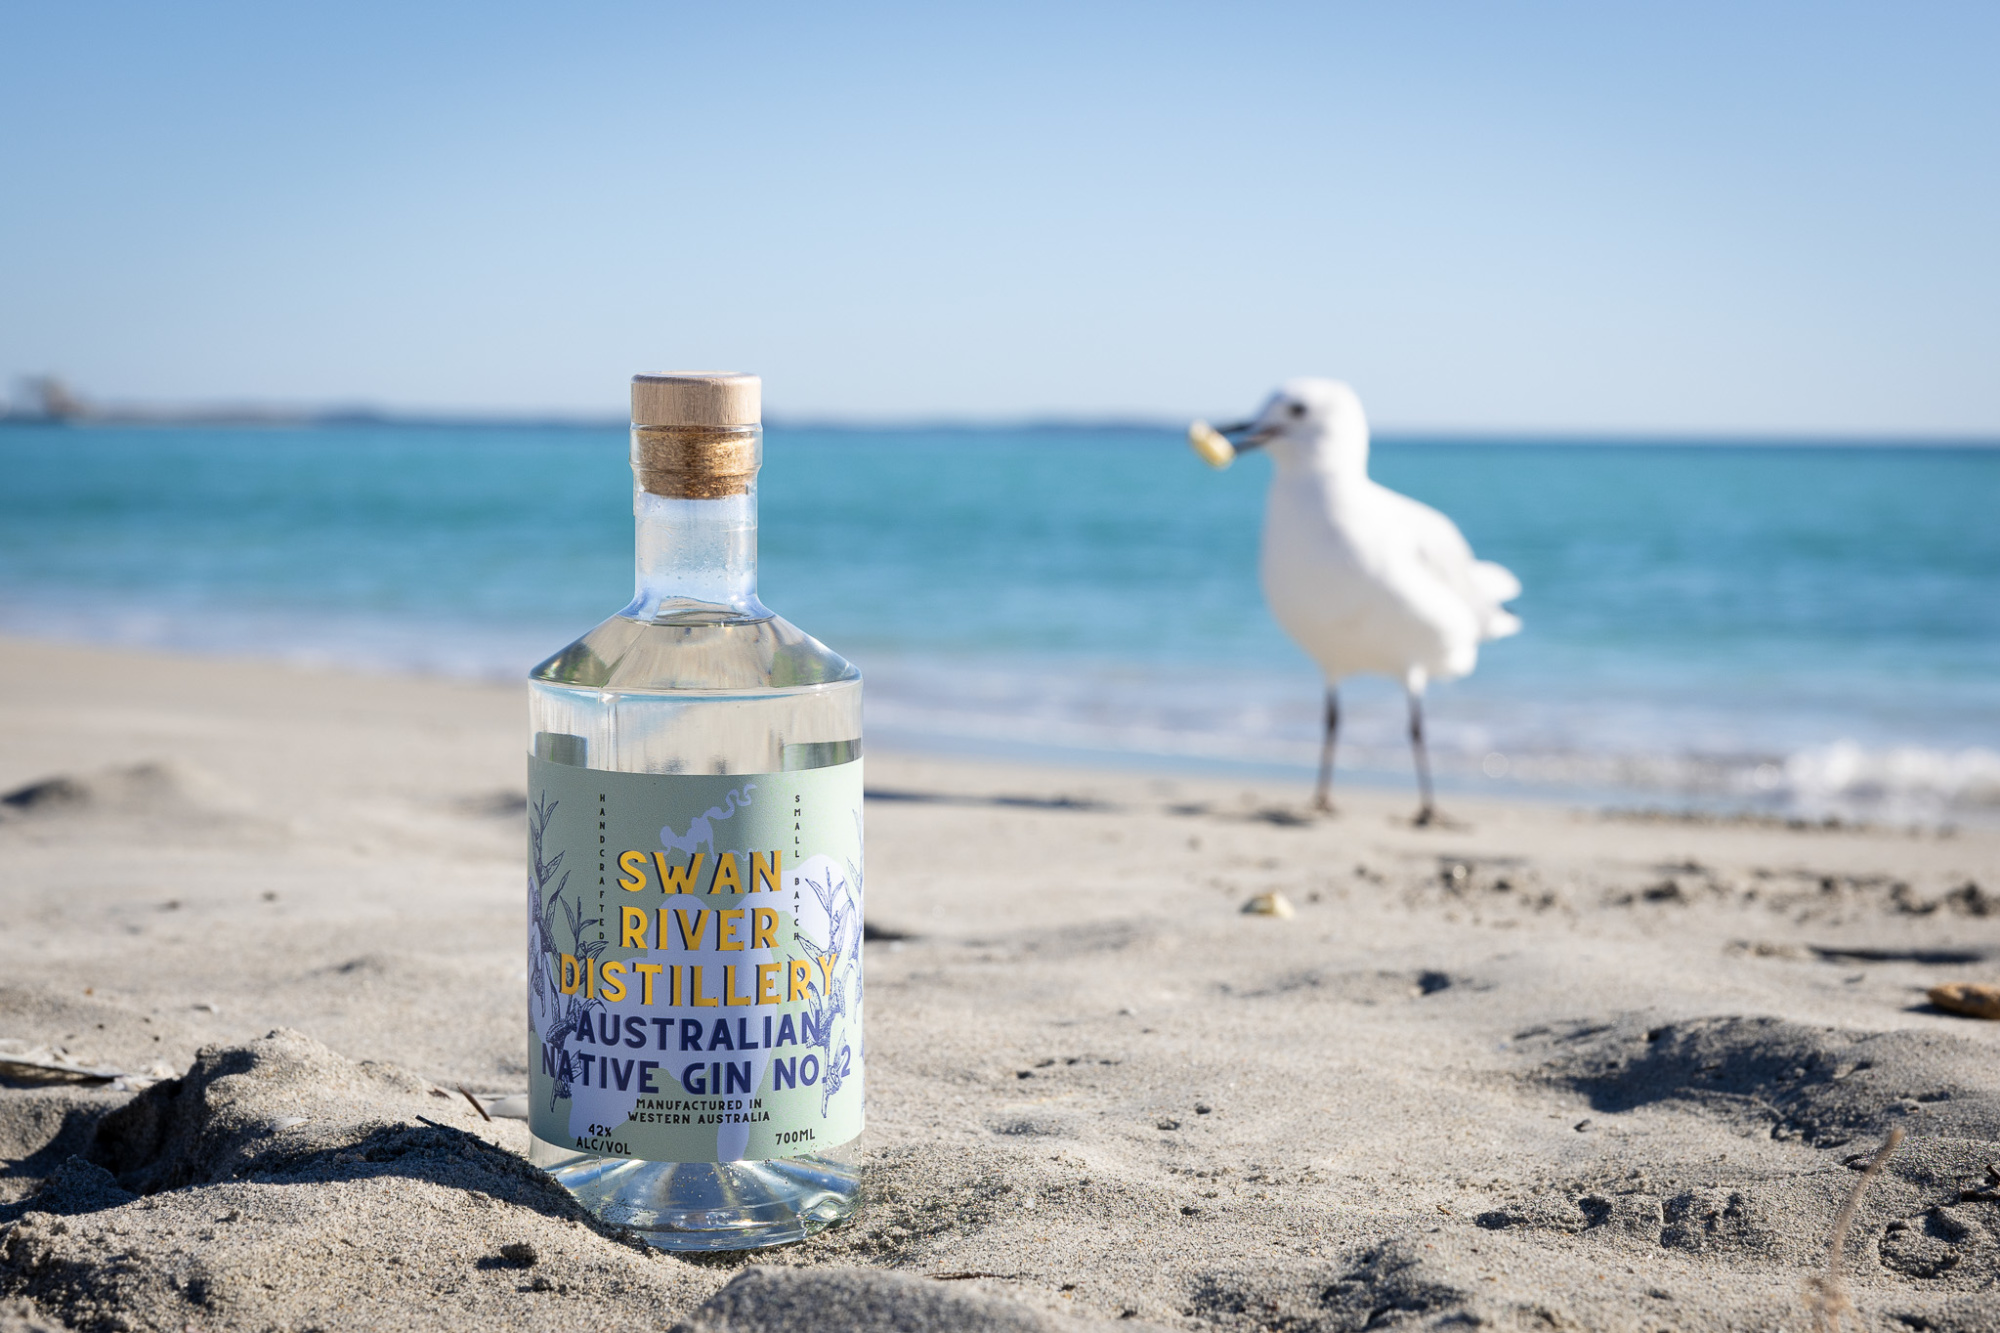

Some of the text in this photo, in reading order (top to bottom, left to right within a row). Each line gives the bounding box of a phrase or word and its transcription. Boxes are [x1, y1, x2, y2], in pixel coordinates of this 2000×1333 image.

[616, 850, 783, 895] SWAN
[618, 905, 780, 951] RIVER
[558, 953, 838, 1008] DISTILLERY
[575, 1010, 821, 1051] AUSTRALIAN
[541, 1043, 660, 1094] NATIVE
[682, 1060, 752, 1095] GIN
[840, 1045, 851, 1078] 2
[628, 1111, 770, 1125] WESTERN AUSTRALIA
[636, 1098, 762, 1111] MANUFACTURED IN
[576, 1136, 632, 1156] ALC/VOL
[588, 1124, 612, 1138] 42%
[775, 1128, 816, 1146] 700ML
